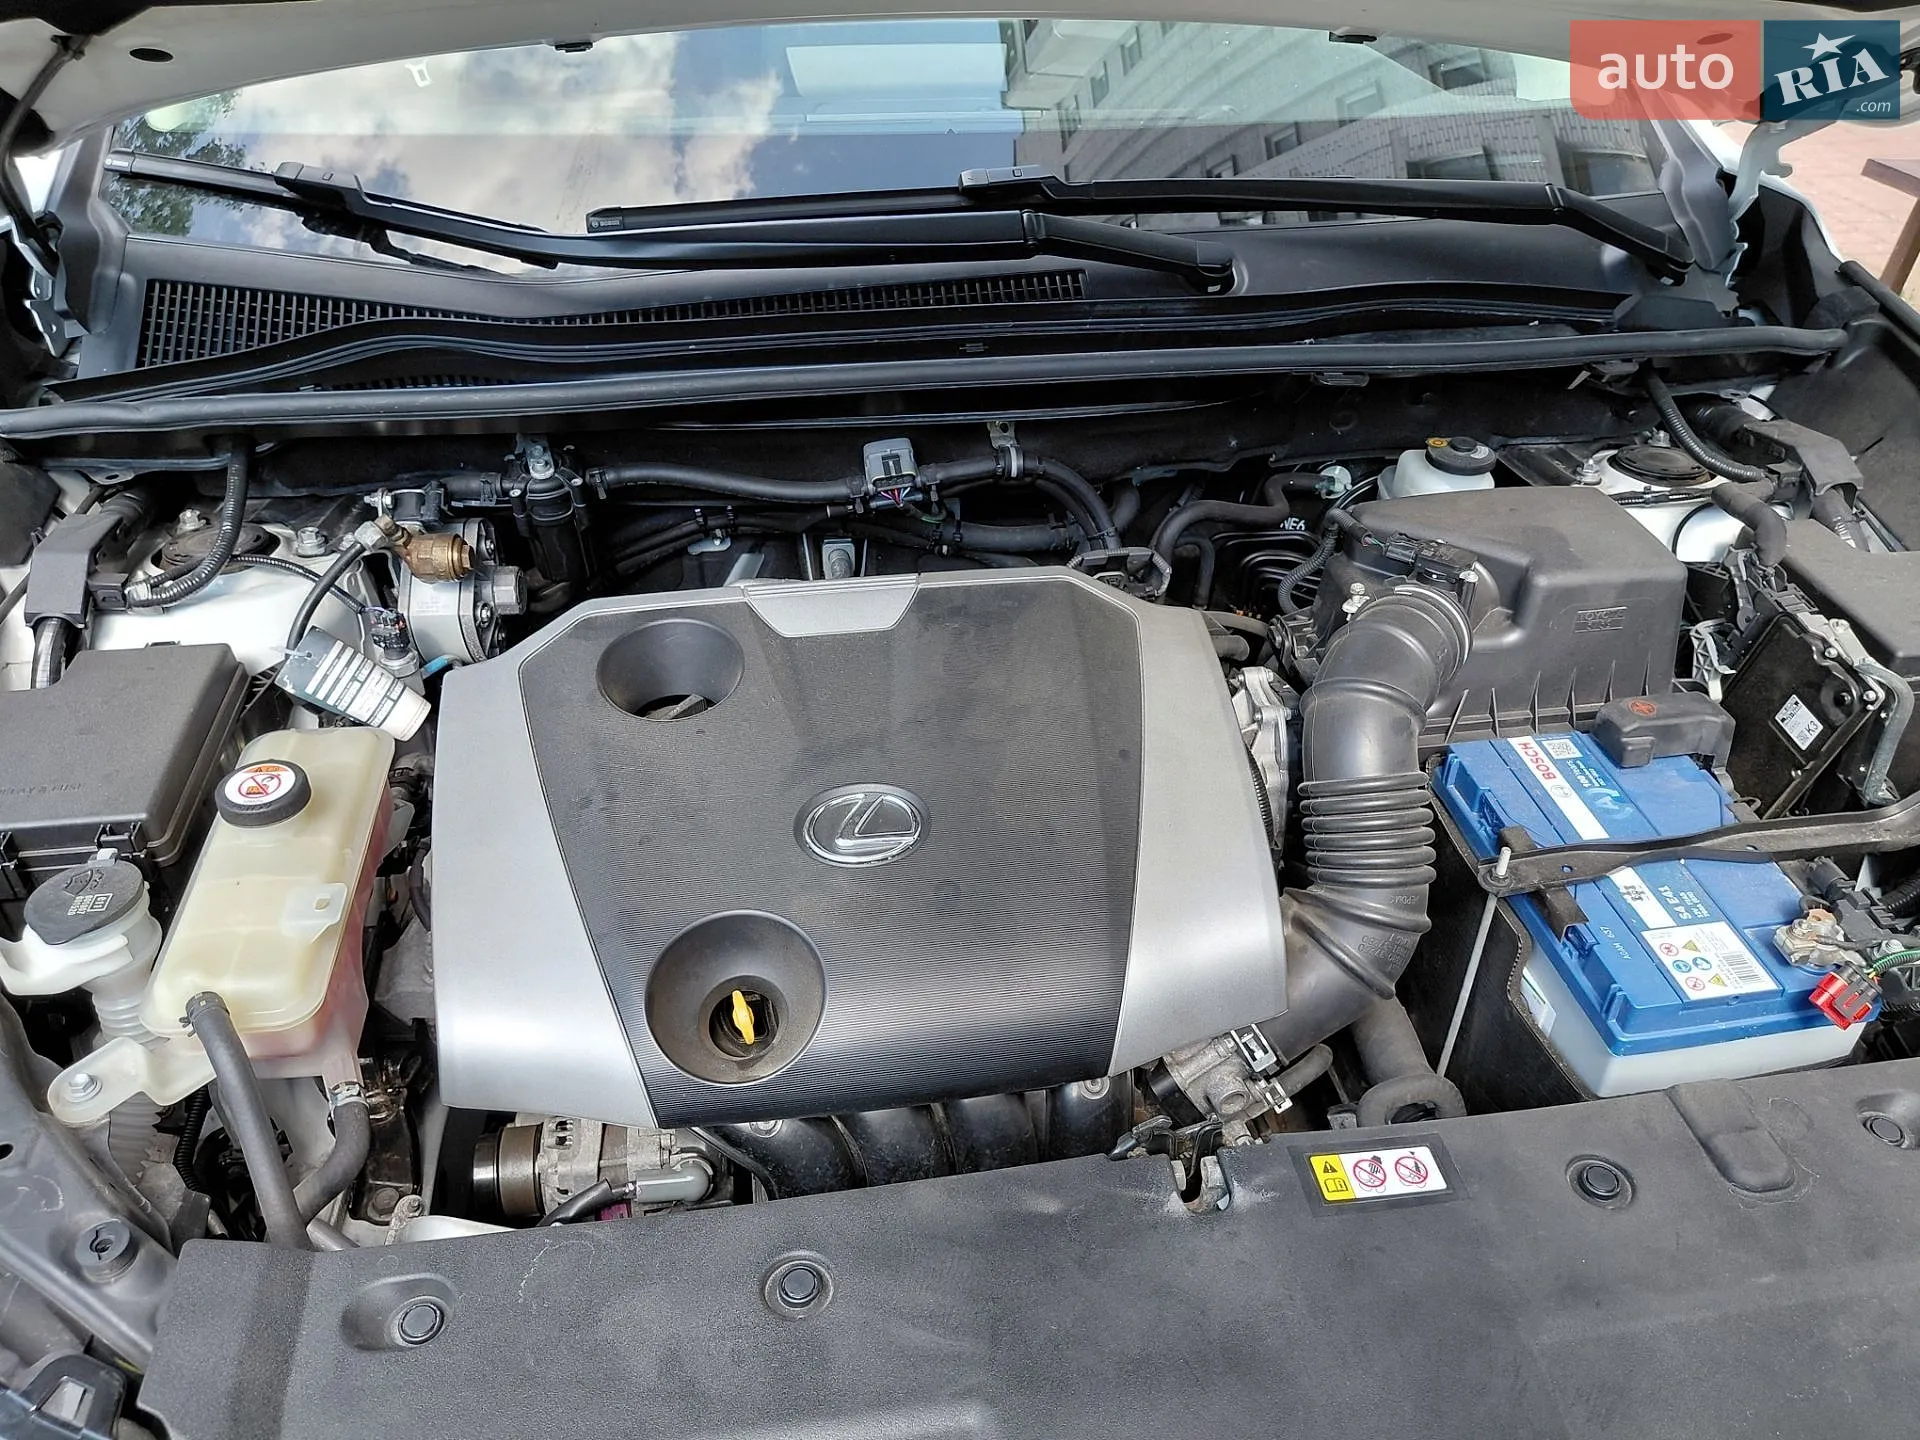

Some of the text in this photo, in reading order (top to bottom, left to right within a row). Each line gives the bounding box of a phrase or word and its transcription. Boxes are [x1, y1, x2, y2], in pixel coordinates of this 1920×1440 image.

[1804, 720, 1819, 736] K3
[1518, 743, 1557, 780] BOSCH
[1657, 885, 1680, 904] E41
[1673, 905, 1692, 920] S4
